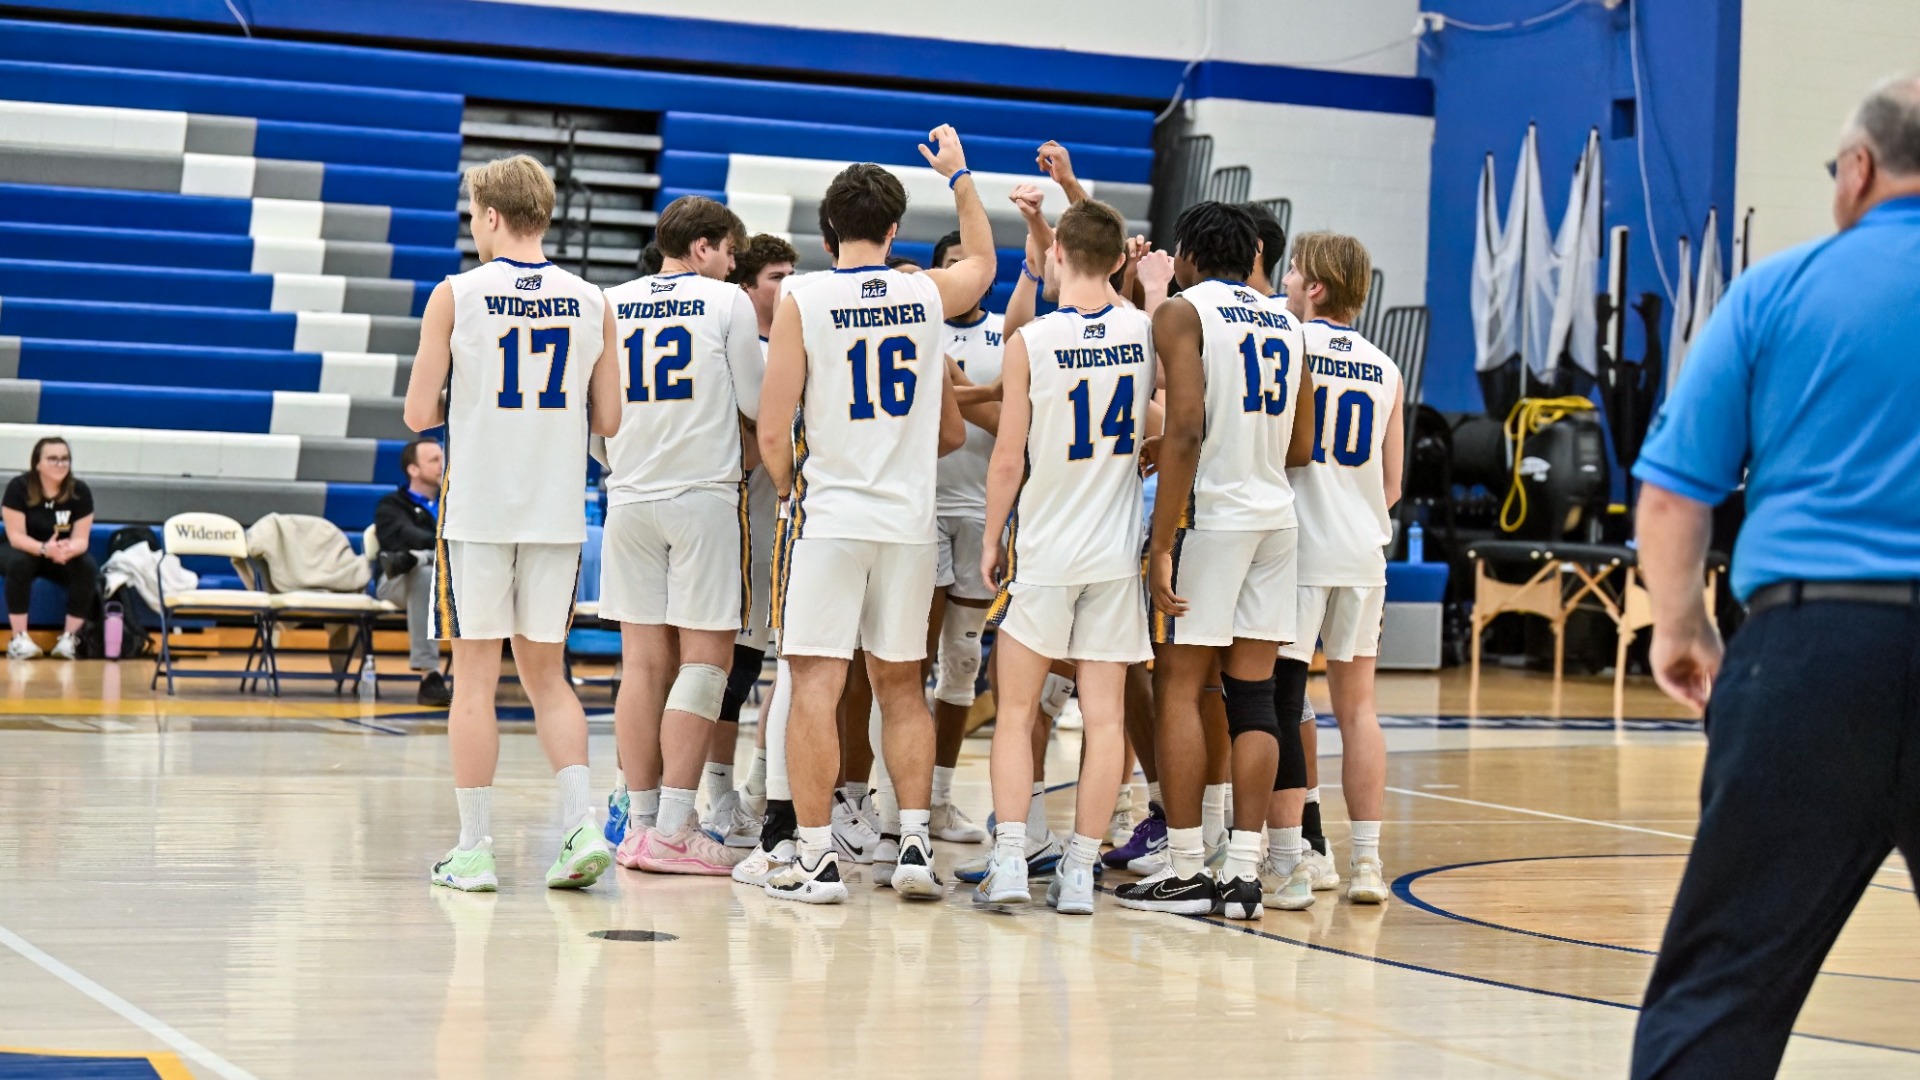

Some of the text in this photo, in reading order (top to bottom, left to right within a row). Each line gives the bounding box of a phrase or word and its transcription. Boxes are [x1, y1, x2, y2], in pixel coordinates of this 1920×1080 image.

[484, 296, 581, 318] WIDENER
[617, 300, 705, 319] WIDENER
[830, 303, 926, 329] WIDENER
[1217, 306, 1292, 331] WIDENER
[984, 330, 1002, 347] W
[496, 325, 571, 410] 17
[623, 324, 694, 403] 12
[1054, 343, 1145, 369] WIDENER
[846, 334, 918, 421] 16
[1238, 331, 1290, 416] 13
[1067, 373, 1136, 462] 14
[1311, 384, 1375, 467] 10
[55, 510, 71, 526] W
[175, 524, 237, 541] Widener
